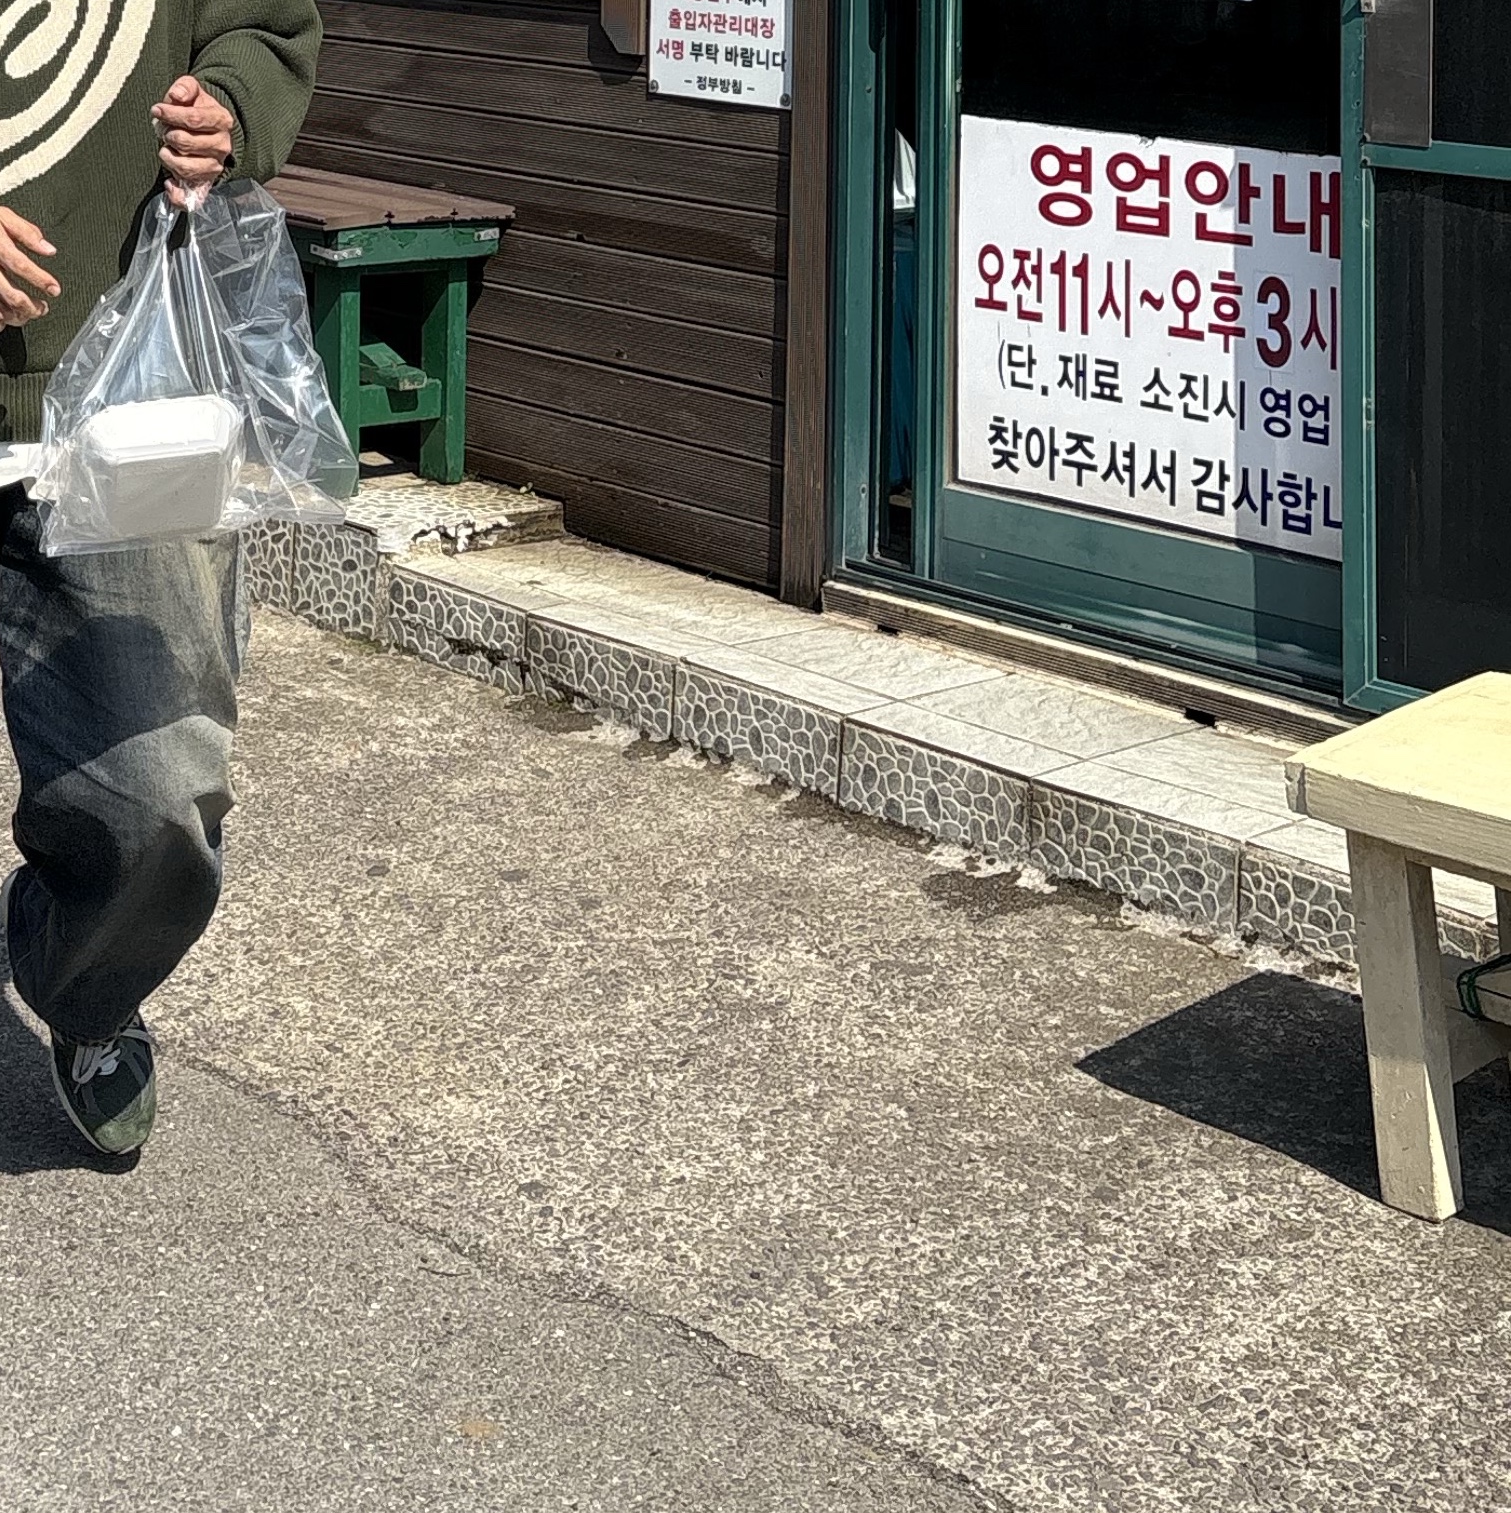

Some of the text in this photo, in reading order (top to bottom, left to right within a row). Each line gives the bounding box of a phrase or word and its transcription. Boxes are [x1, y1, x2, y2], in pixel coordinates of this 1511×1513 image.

[656, 37, 686, 61] 서명
[689, 40, 720, 65] 부탁
[668, 8, 776, 39] 출입자관리대장
[1030, 143, 1342, 260] 영업안내
[1139, 366, 1247, 432] 소진시
[1258, 386, 1331, 447] 영업
[987, 414, 1178, 507] 찾아주셔서
